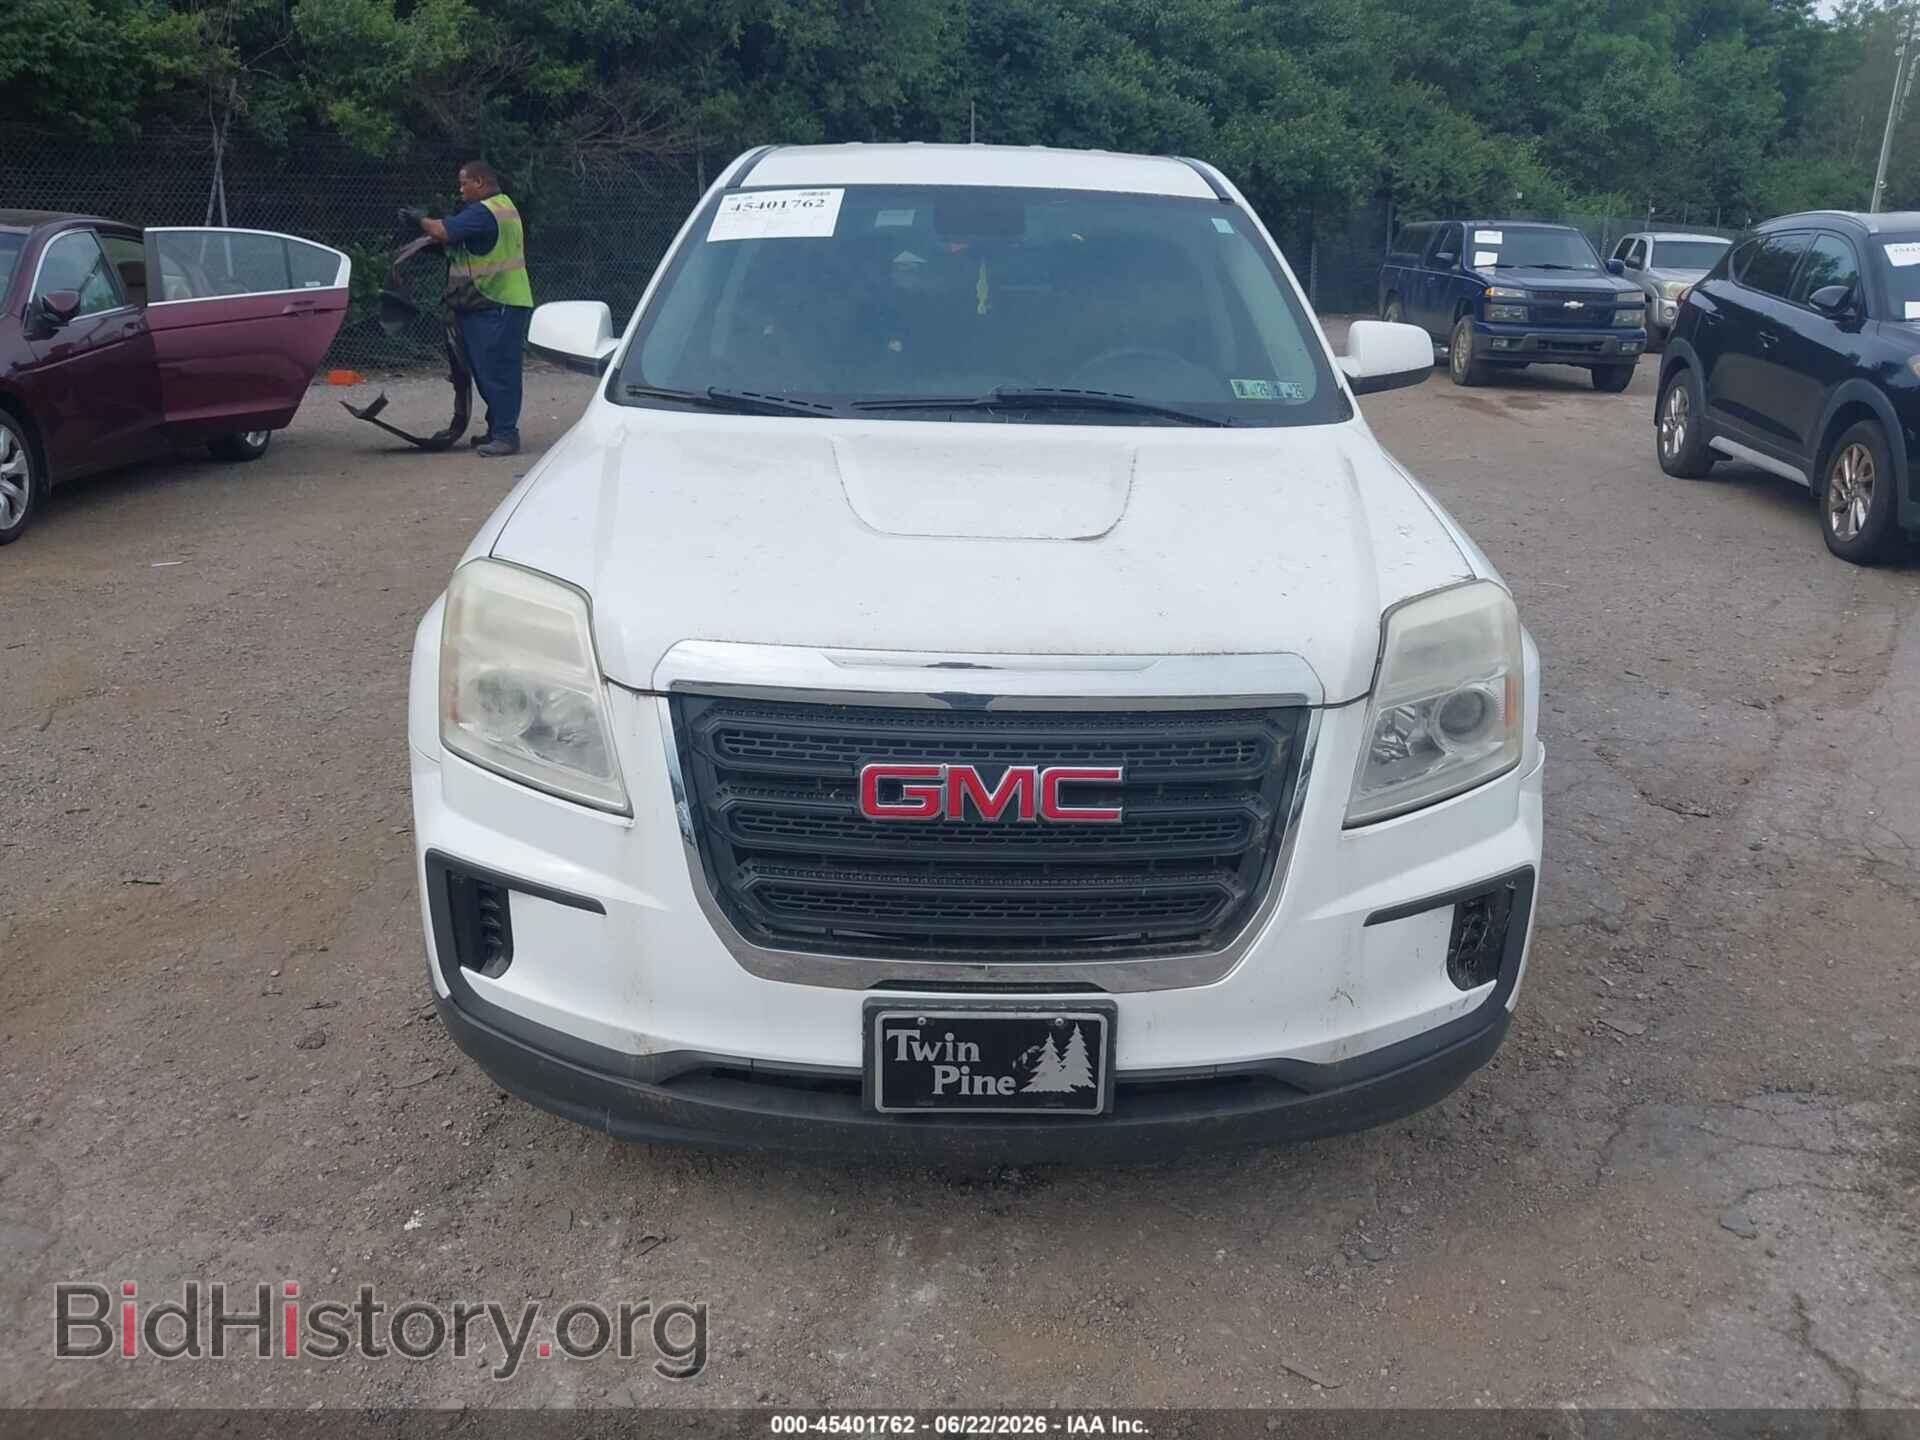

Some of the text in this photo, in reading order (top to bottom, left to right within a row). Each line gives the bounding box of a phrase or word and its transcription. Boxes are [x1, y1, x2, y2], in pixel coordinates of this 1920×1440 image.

[730, 199, 825, 212] 45401762
[859, 763, 1124, 823] GMC
[886, 1029, 981, 1063] Twin
[931, 1065, 1017, 1096] Pine
